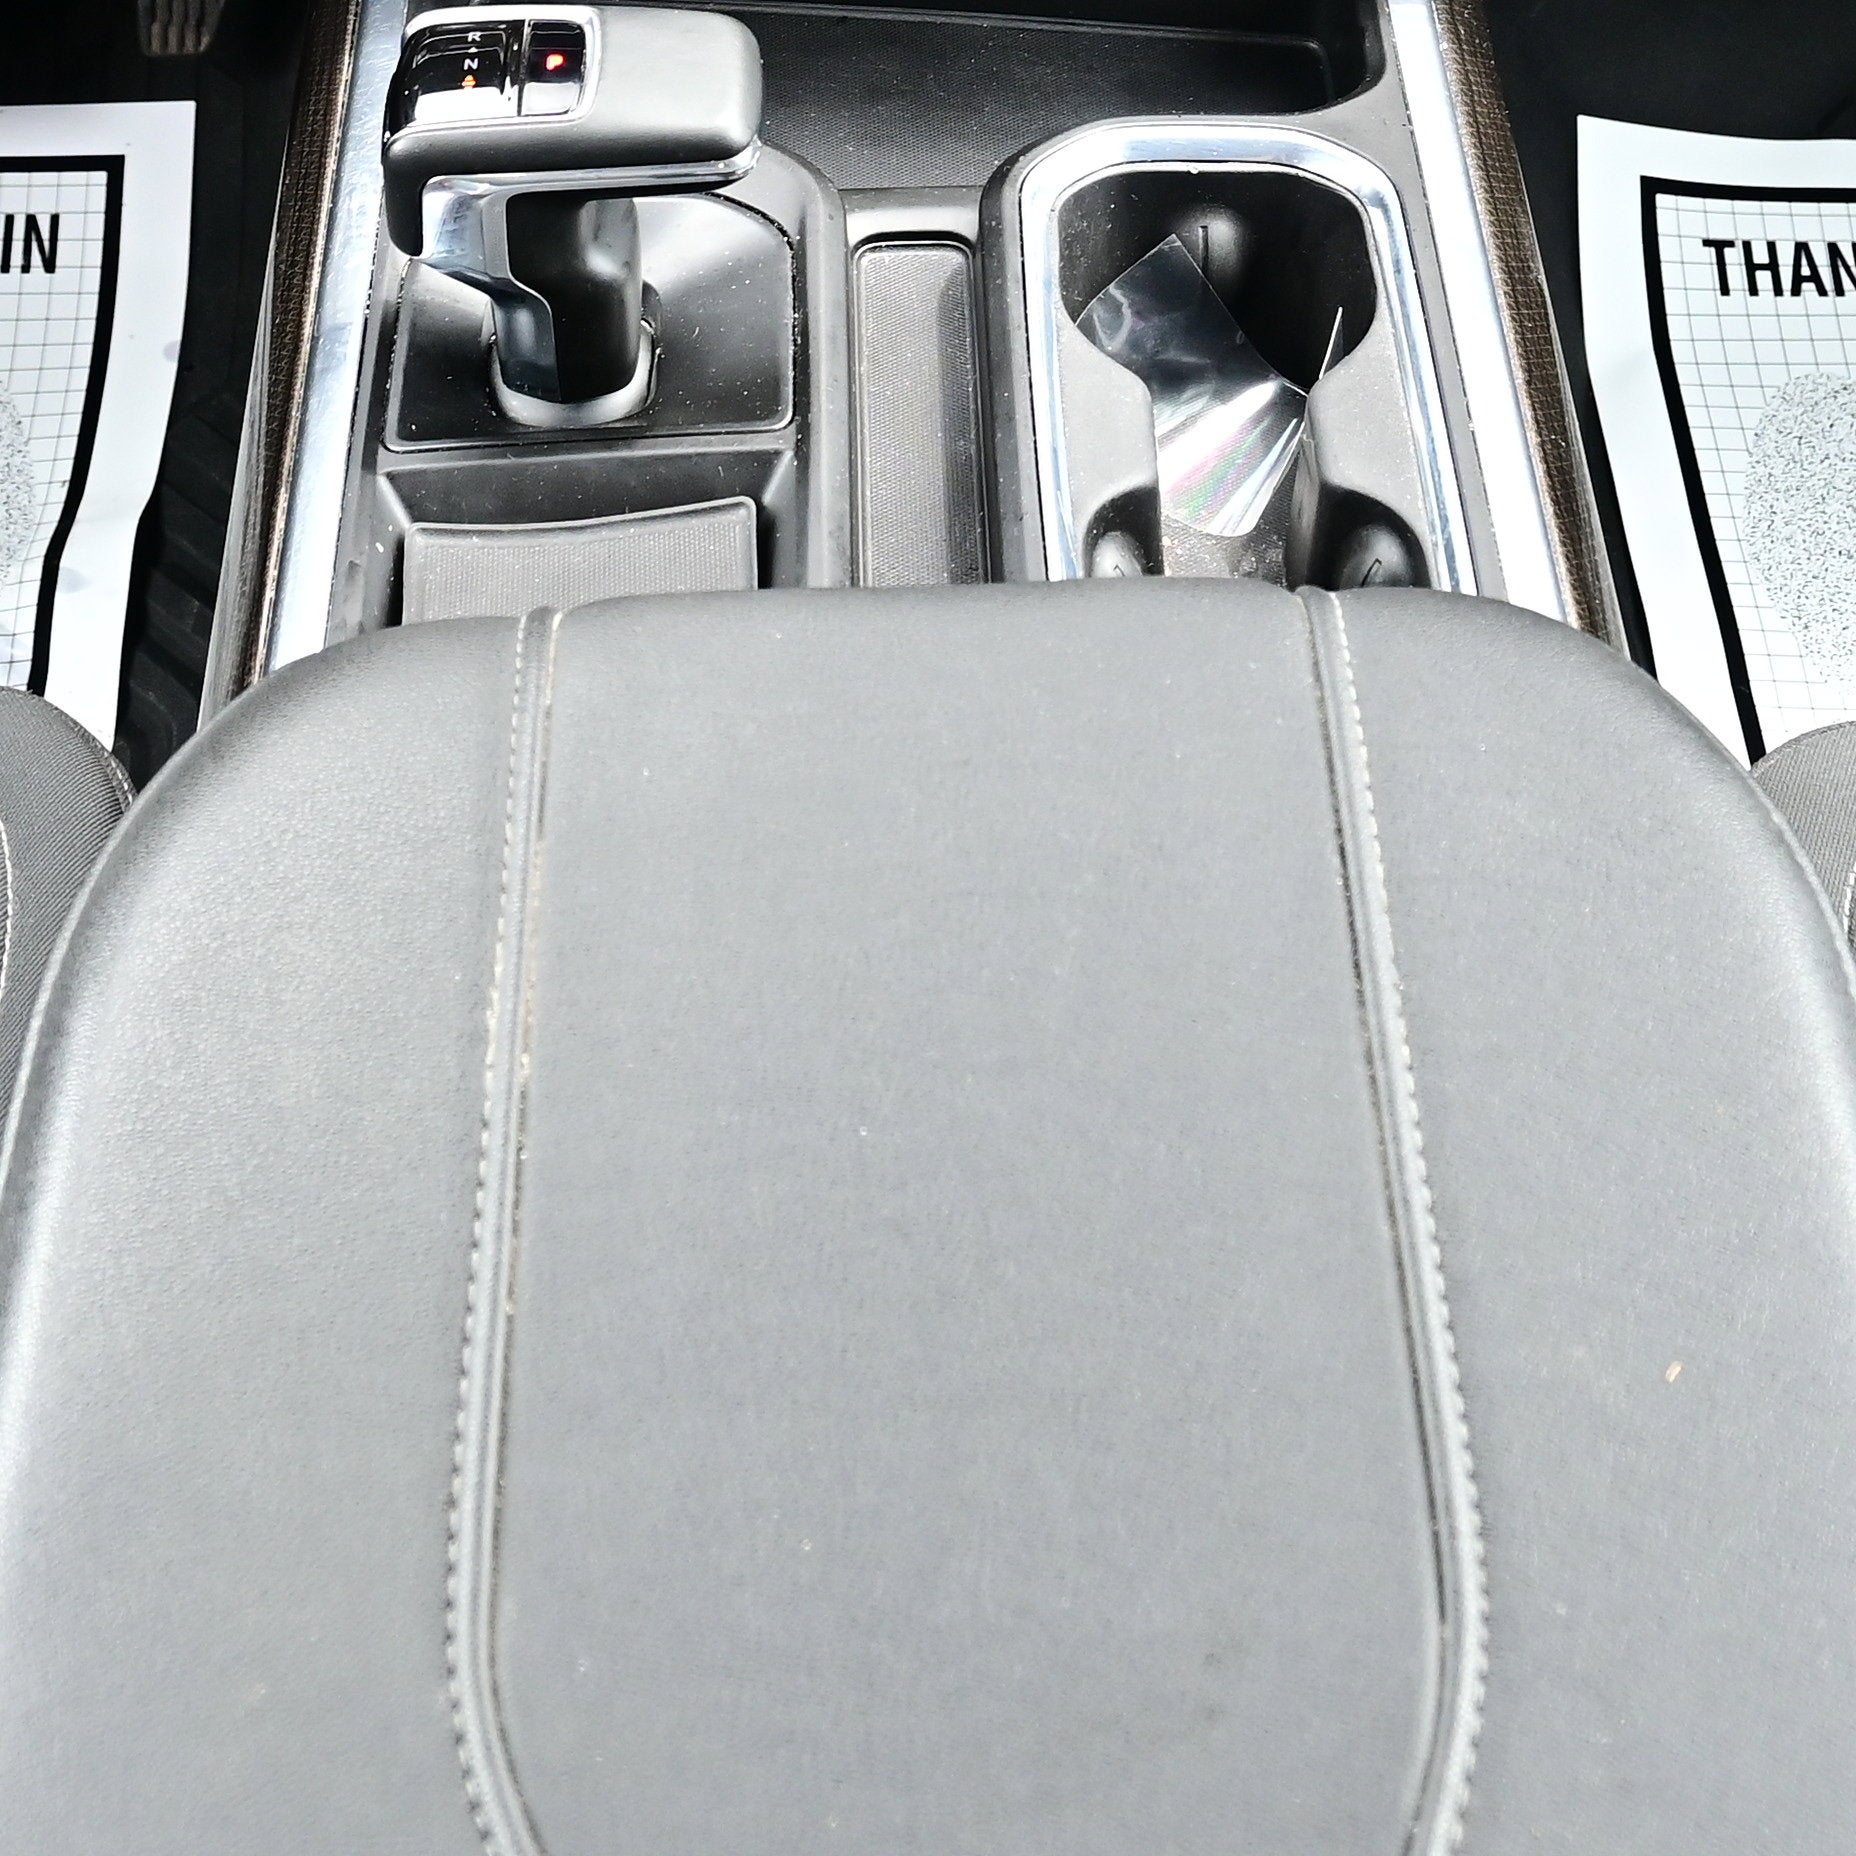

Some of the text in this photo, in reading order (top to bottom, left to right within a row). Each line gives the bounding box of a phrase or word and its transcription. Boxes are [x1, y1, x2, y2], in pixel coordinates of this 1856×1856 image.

[467, 31, 482, 43] R
[463, 58, 479, 71] N
[545, 53, 564, 71] P
[0, 212, 61, 274] IN
